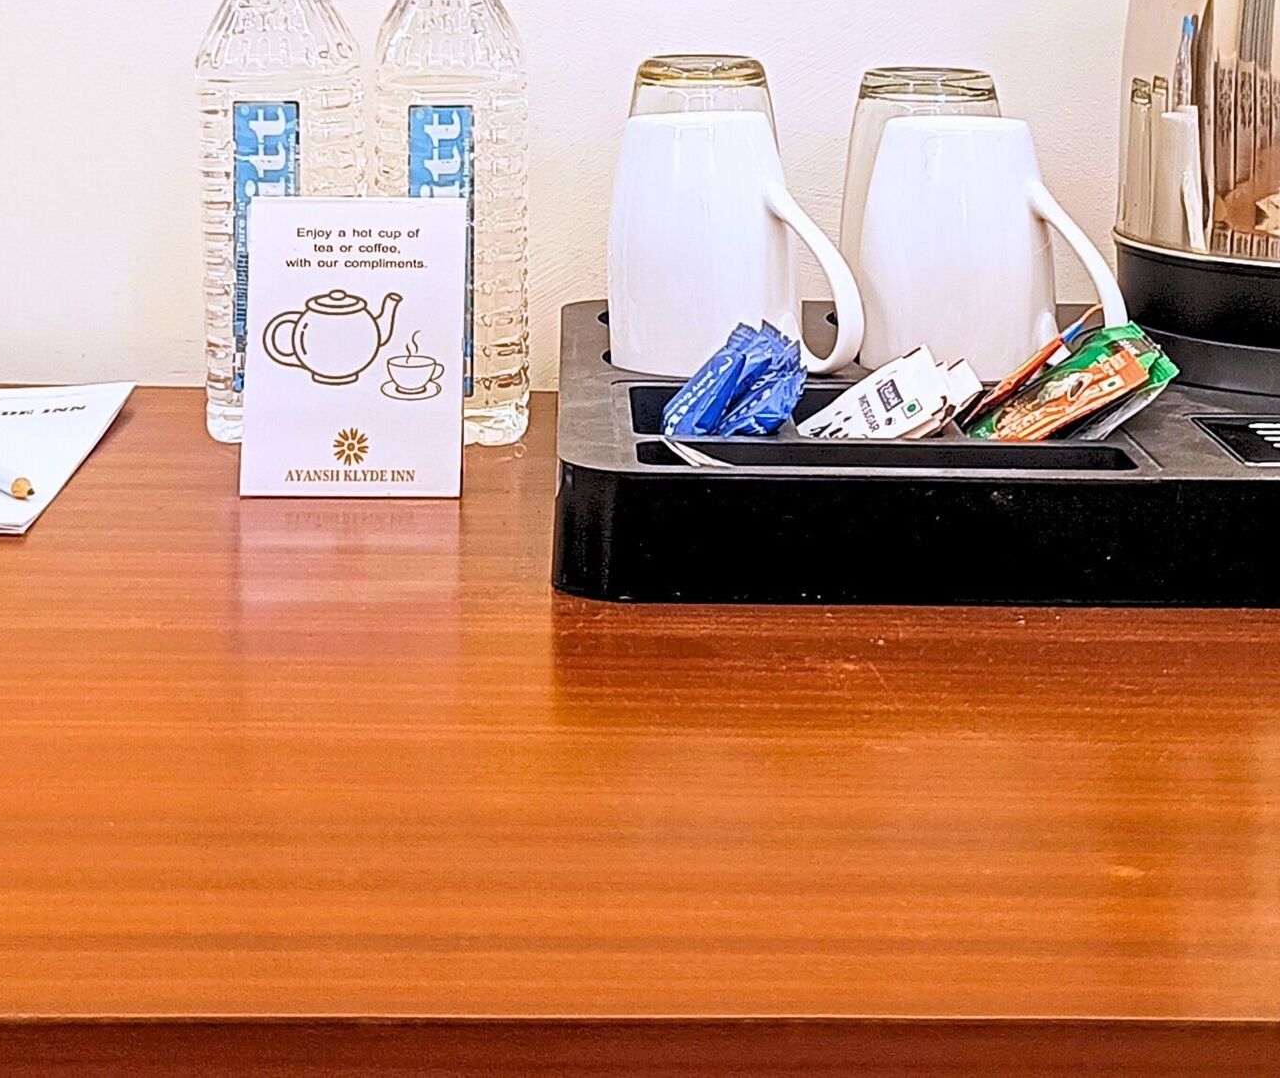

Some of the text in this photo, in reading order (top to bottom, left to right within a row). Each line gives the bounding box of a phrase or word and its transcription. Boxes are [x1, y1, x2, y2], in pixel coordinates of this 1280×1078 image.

[245, 106, 287, 197] itt
[419, 110, 462, 198] itt
[297, 227, 420, 240] Enjoy a hot cup of
[314, 243, 401, 254] tea or coffee,
[285, 258, 428, 270] with our compliments.
[284, 469, 416, 482] AYANSH KLYDE INN
